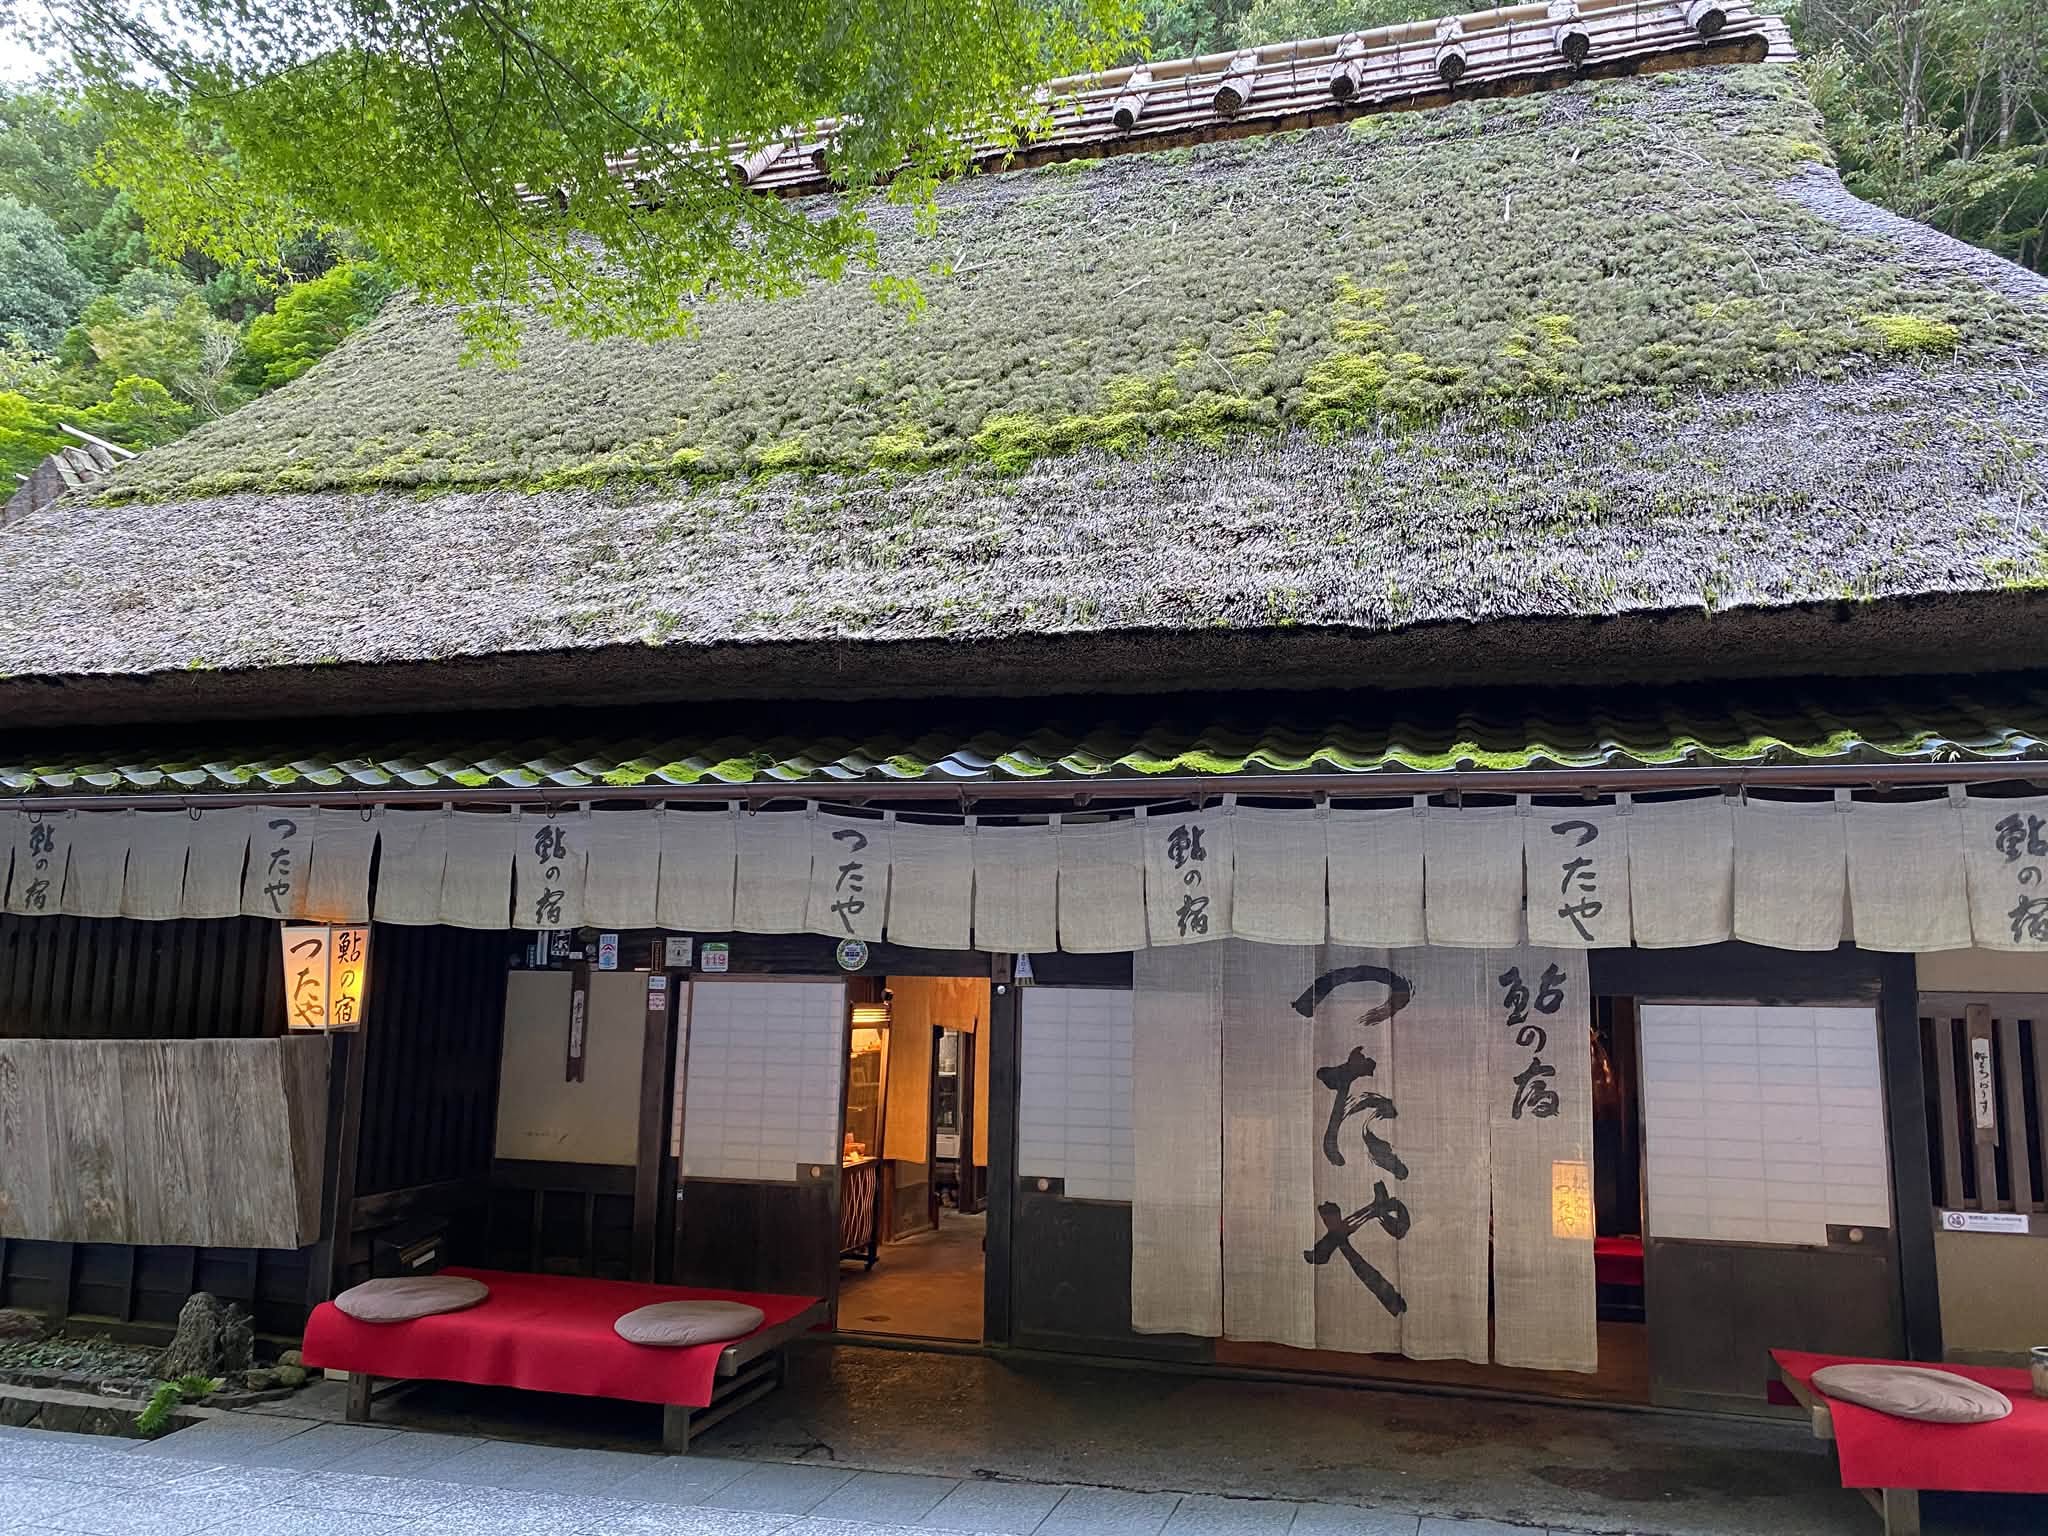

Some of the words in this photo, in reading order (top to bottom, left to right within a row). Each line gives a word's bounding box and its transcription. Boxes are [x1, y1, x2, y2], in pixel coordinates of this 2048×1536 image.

[25, 823, 56, 910] 鮎の宿
[263, 819, 296, 913] つたや
[535, 825, 566, 924] 鮎の宿
[832, 829, 868, 933] つたや
[1167, 824, 1210, 936] 鮎の宿
[1551, 820, 1602, 941] つたや
[290, 938, 325, 1028] つたや
[334, 930, 362, 1025] 鮎の宿
[1499, 963, 1567, 1120] 鮎の宿
[1291, 964, 1416, 1317] つたや
